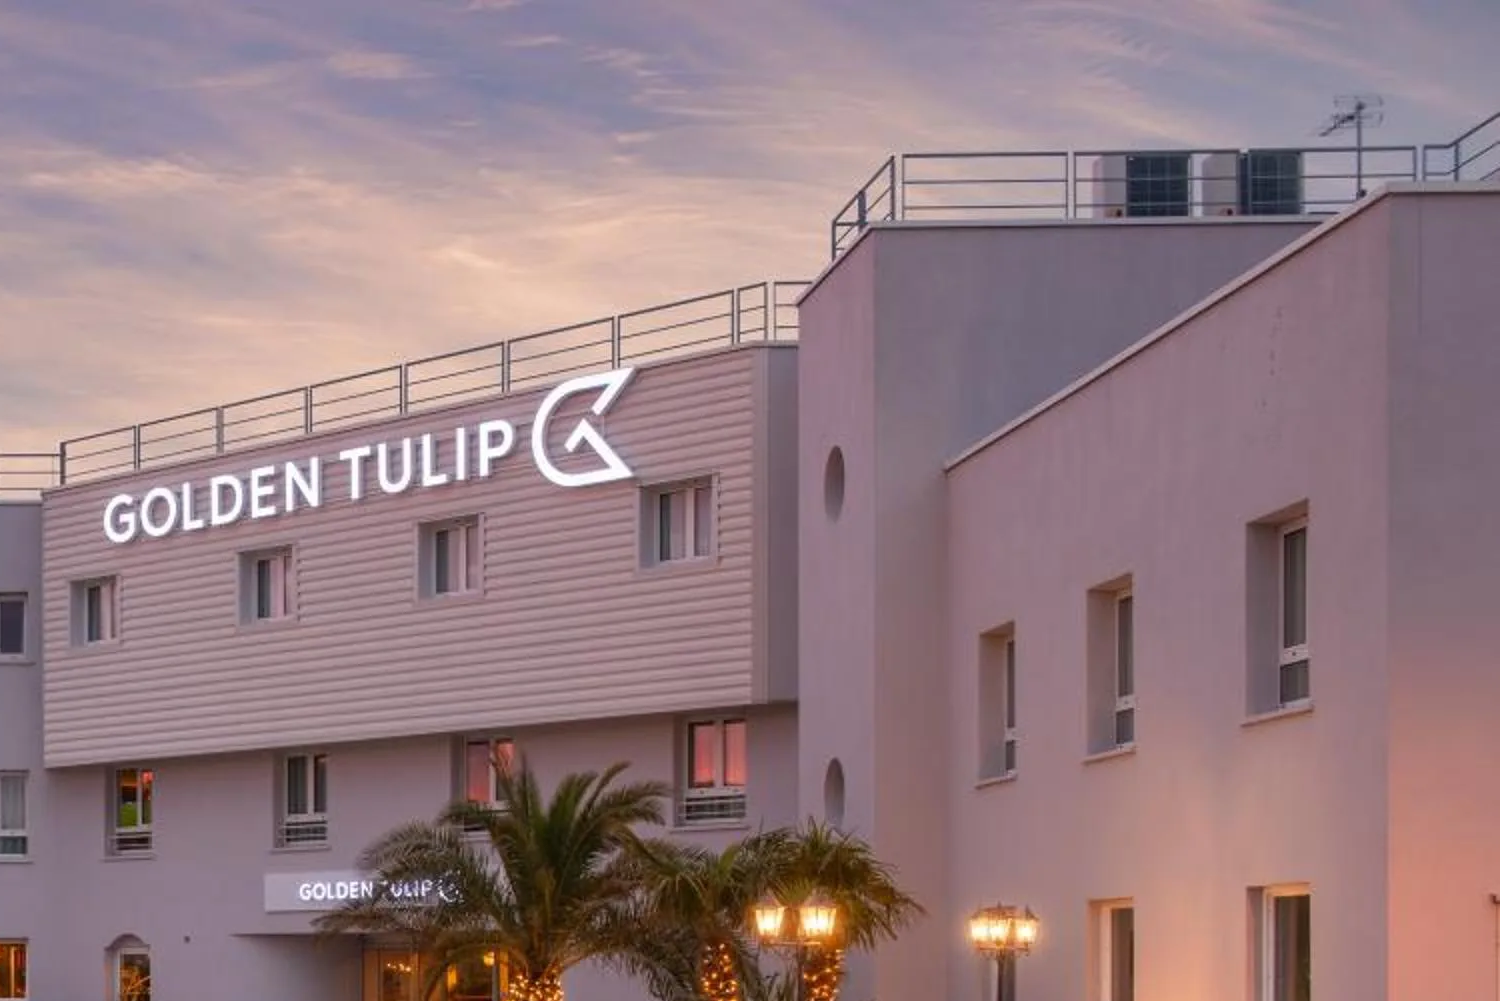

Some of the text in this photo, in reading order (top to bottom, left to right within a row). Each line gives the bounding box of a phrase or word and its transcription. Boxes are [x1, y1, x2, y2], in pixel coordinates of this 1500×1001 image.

[102, 419, 514, 544] GOLDEN TULIP
[299, 880, 373, 900] GOLDEN
